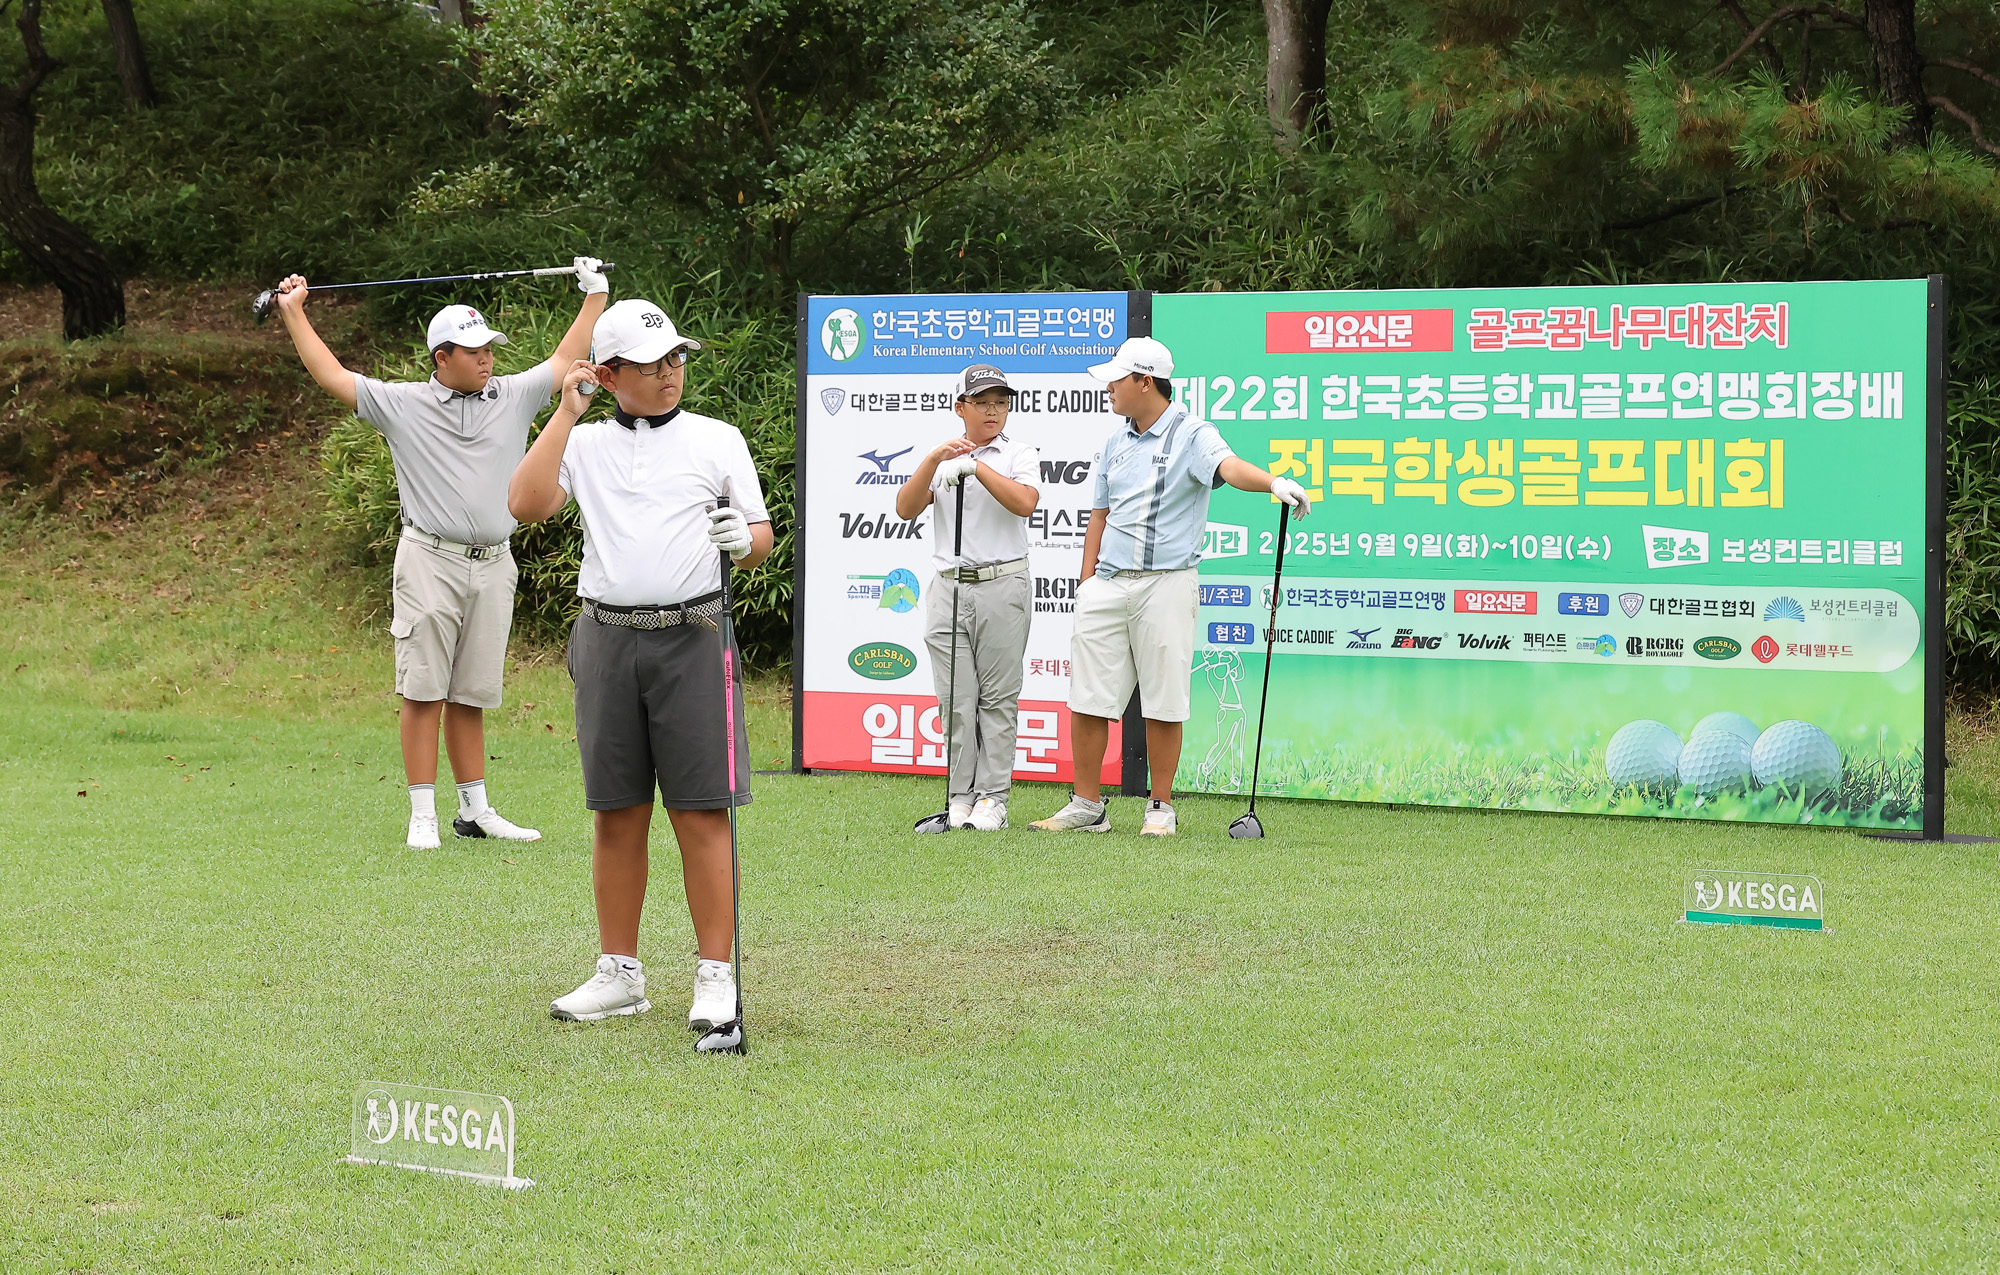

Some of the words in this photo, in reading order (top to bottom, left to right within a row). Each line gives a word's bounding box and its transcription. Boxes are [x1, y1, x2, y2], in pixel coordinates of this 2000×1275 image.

[641, 313, 664, 328] JP
[872, 307, 1115, 339] 한국초등학교골프연맹
[1467, 301, 1789, 352] 골프꿈나무대잔치
[1304, 315, 1413, 348] 일요신문
[873, 345, 907, 357] Korea
[911, 344, 975, 359] Elementary
[979, 342, 1017, 356] School
[1020, 341, 1046, 356] Golf
[1049, 341, 1115, 356] Association
[851, 393, 952, 412] 대한골프협회
[1048, 389, 1109, 413] CADDIE
[1170, 374, 1308, 420] 제22회
[1321, 371, 1904, 420] 한국초등학교골프연맹회장배
[1268, 436, 1785, 509] 전국학생골프대회
[839, 513, 925, 540] Volvik
[1200, 531, 1240, 554] 기간
[1258, 530, 1351, 557] 2025년
[1357, 532, 1396, 558] 9월
[1403, 532, 1612, 562] 9일(화)~10일(수)
[1652, 536, 1701, 562] 장소
[1722, 537, 1903, 567] 보성컨트리클럽
[847, 584, 882, 600] 스파클
[1286, 588, 1446, 612] 한국초등학교골프연맹
[1464, 592, 1526, 613] 일요신문
[1567, 595, 1600, 614] 후원
[1650, 597, 1755, 618] 대한골프협회
[1809, 599, 1899, 618] 보성컨트리클럽
[1215, 624, 1247, 642] 협찬
[1262, 628, 1293, 643] VOICE
[1296, 629, 1335, 645] CADDIE
[1457, 633, 1515, 650] Volvik
[1523, 633, 1567, 648] 퍼티스트
[1346, 641, 1382, 649] MIZUNO
[1646, 637, 1684, 650] RGRG
[1697, 640, 1738, 653] CARLSBAD
[1786, 643, 1853, 657] 롯데웰푸드
[854, 648, 911, 668] CARLSBAD
[872, 661, 893, 669] GOLF
[862, 703, 1058, 773] 일요문
[1728, 881, 1818, 913] KESGA
[404, 1100, 506, 1153] KESGA
